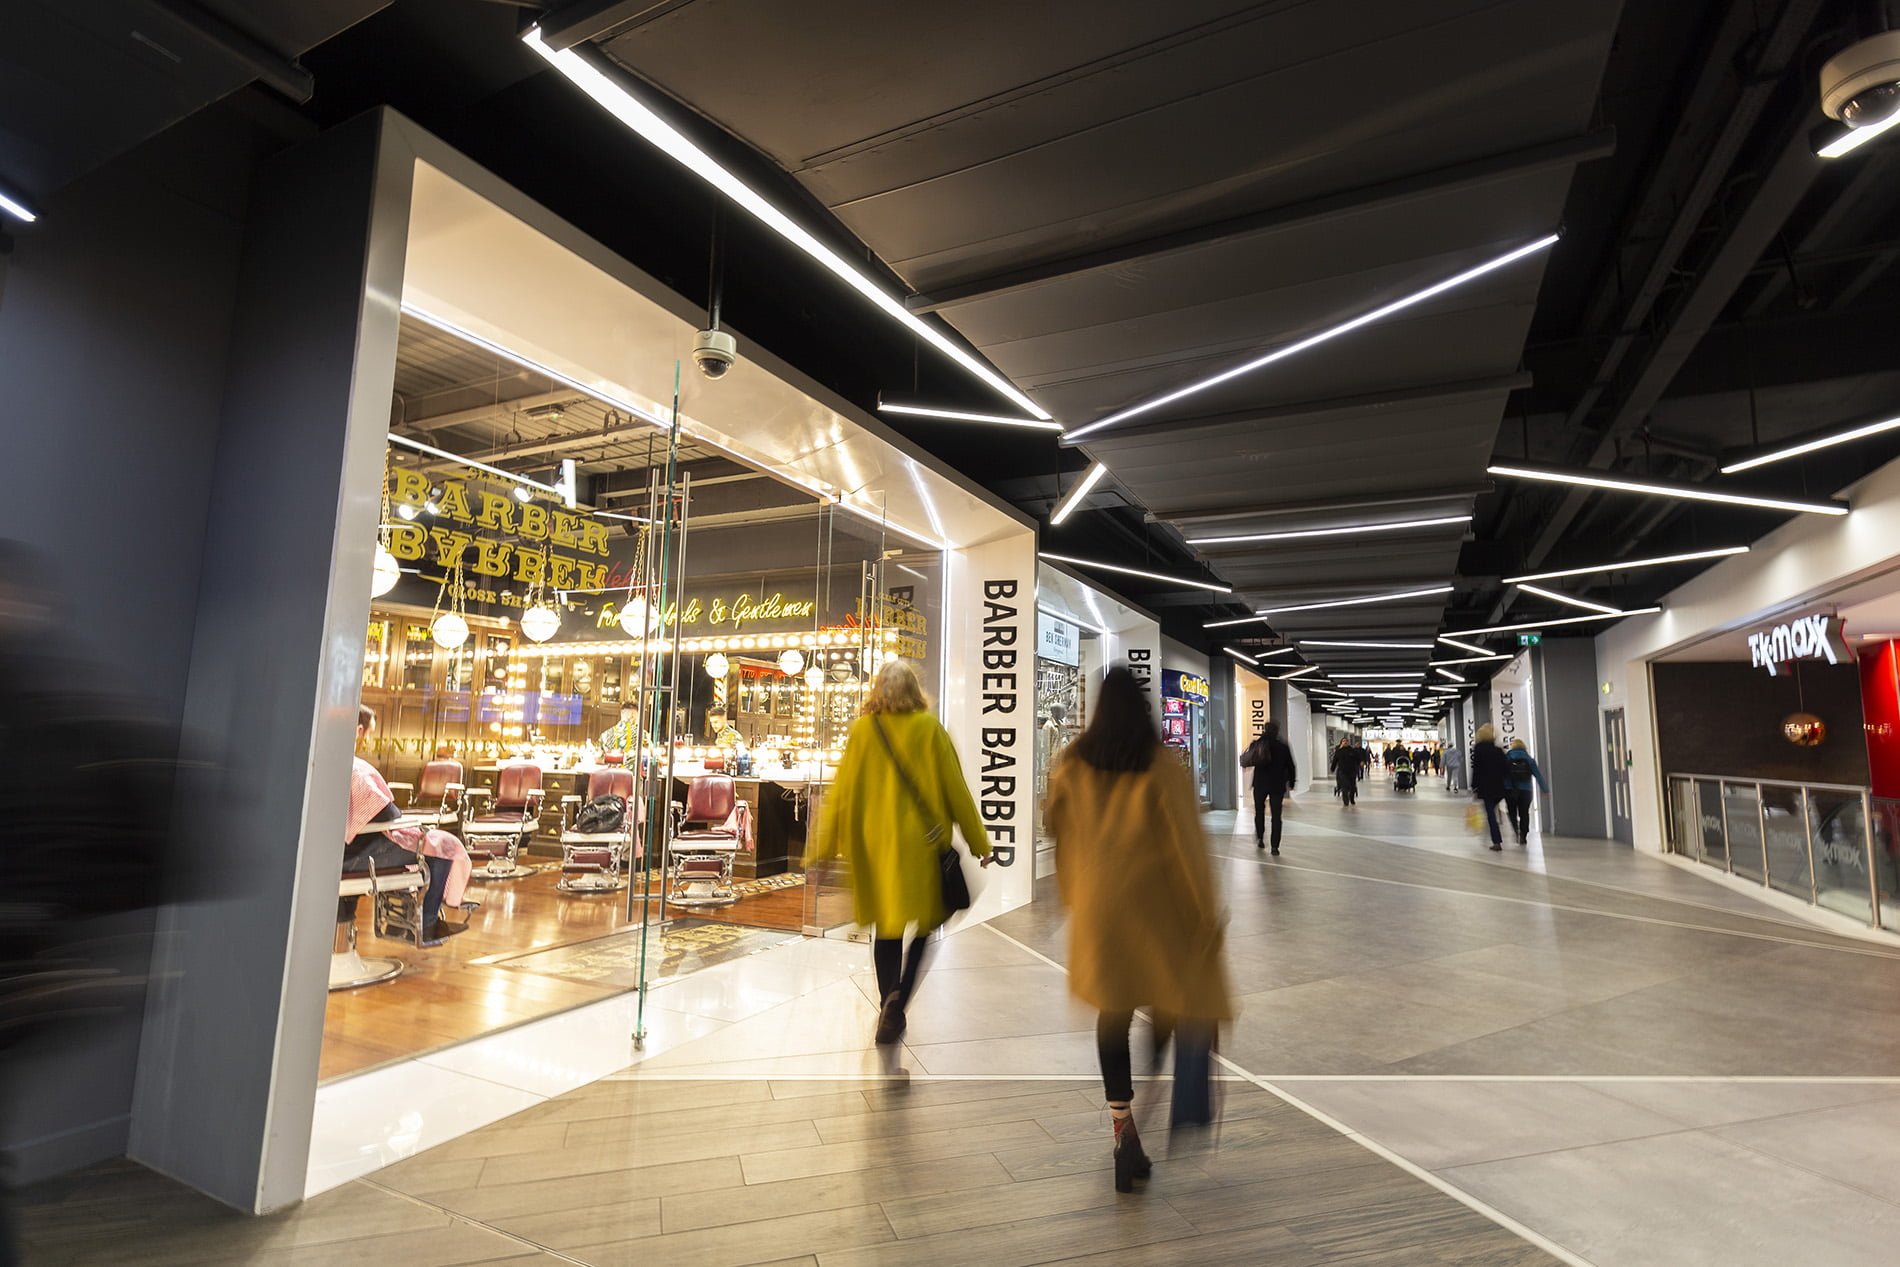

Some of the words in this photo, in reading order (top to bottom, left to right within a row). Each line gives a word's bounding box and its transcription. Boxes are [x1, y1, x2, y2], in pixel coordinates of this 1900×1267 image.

[391, 466, 610, 557] BARBER
[710, 598, 727, 625] &
[731, 592, 813, 629] Gentlemen
[982, 579, 1018, 715] BARBER
[1500, 692, 1515, 733] CHOICE
[980, 727, 1017, 869] BARBER
